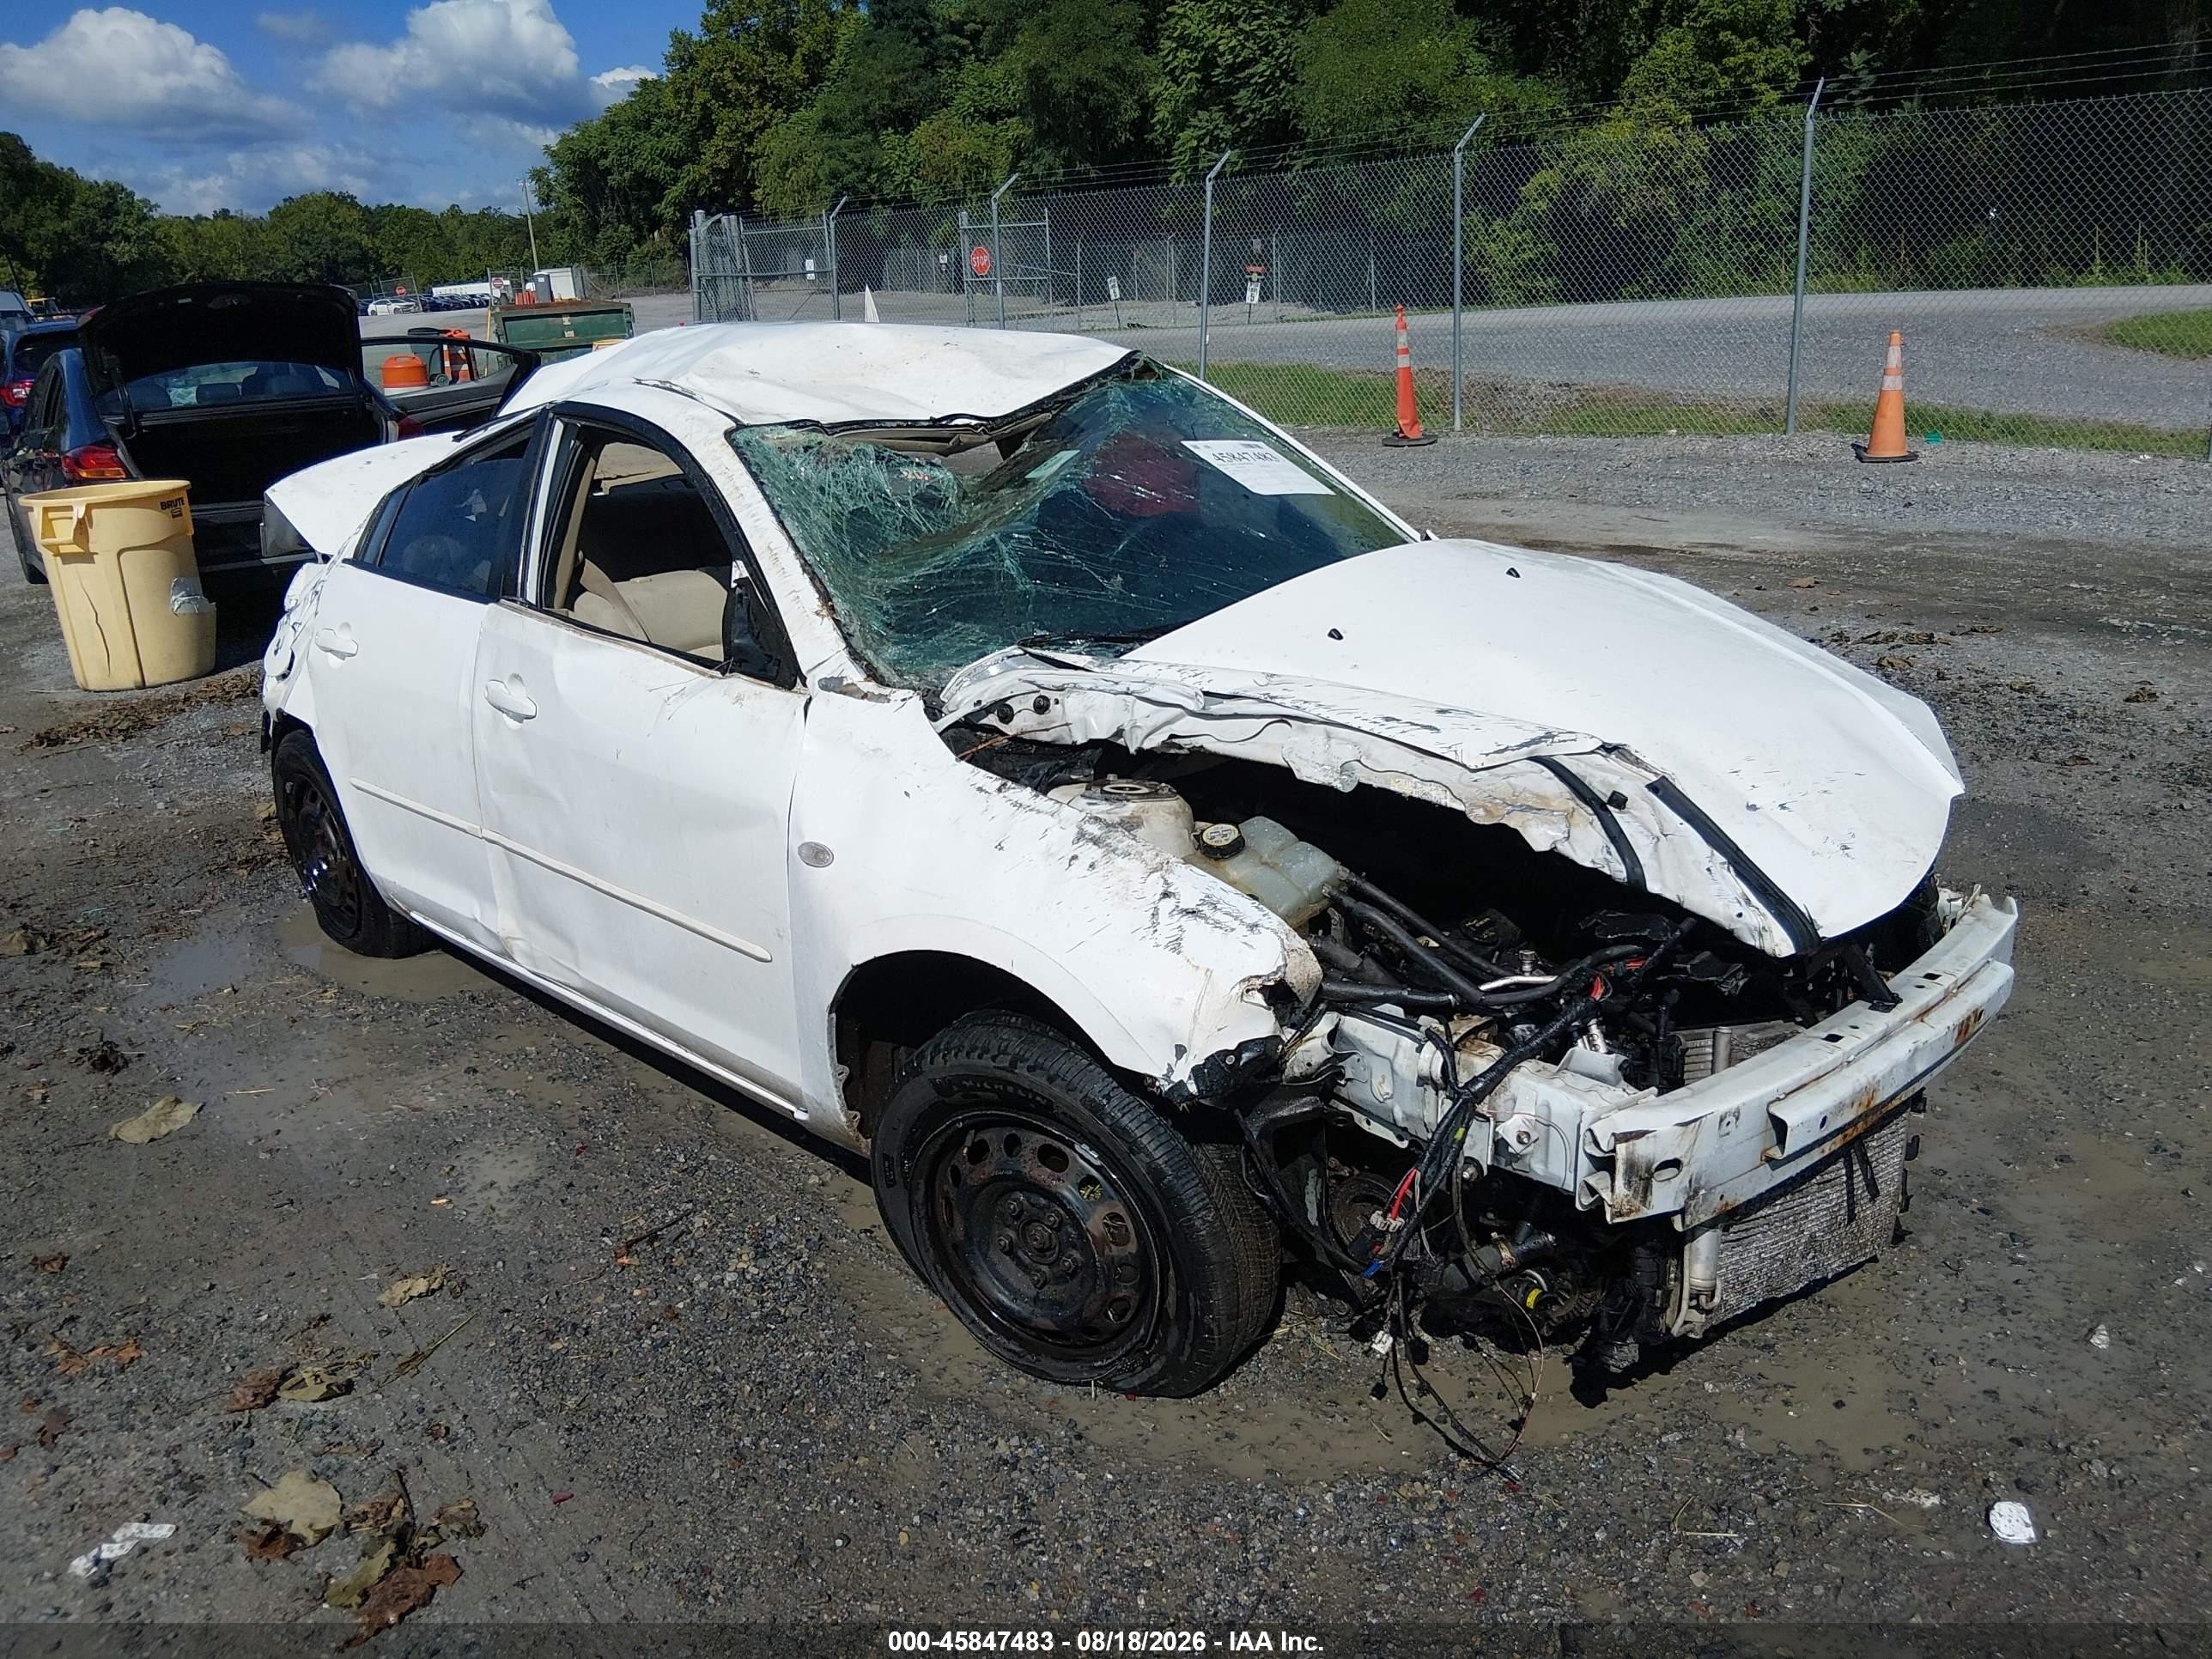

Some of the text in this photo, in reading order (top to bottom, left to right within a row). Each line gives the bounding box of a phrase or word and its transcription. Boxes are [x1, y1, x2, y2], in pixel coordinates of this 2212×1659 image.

[972, 255, 988, 267] STOP
[1212, 452, 1280, 463] 45847483
[160, 497, 185, 510] BRUTE
